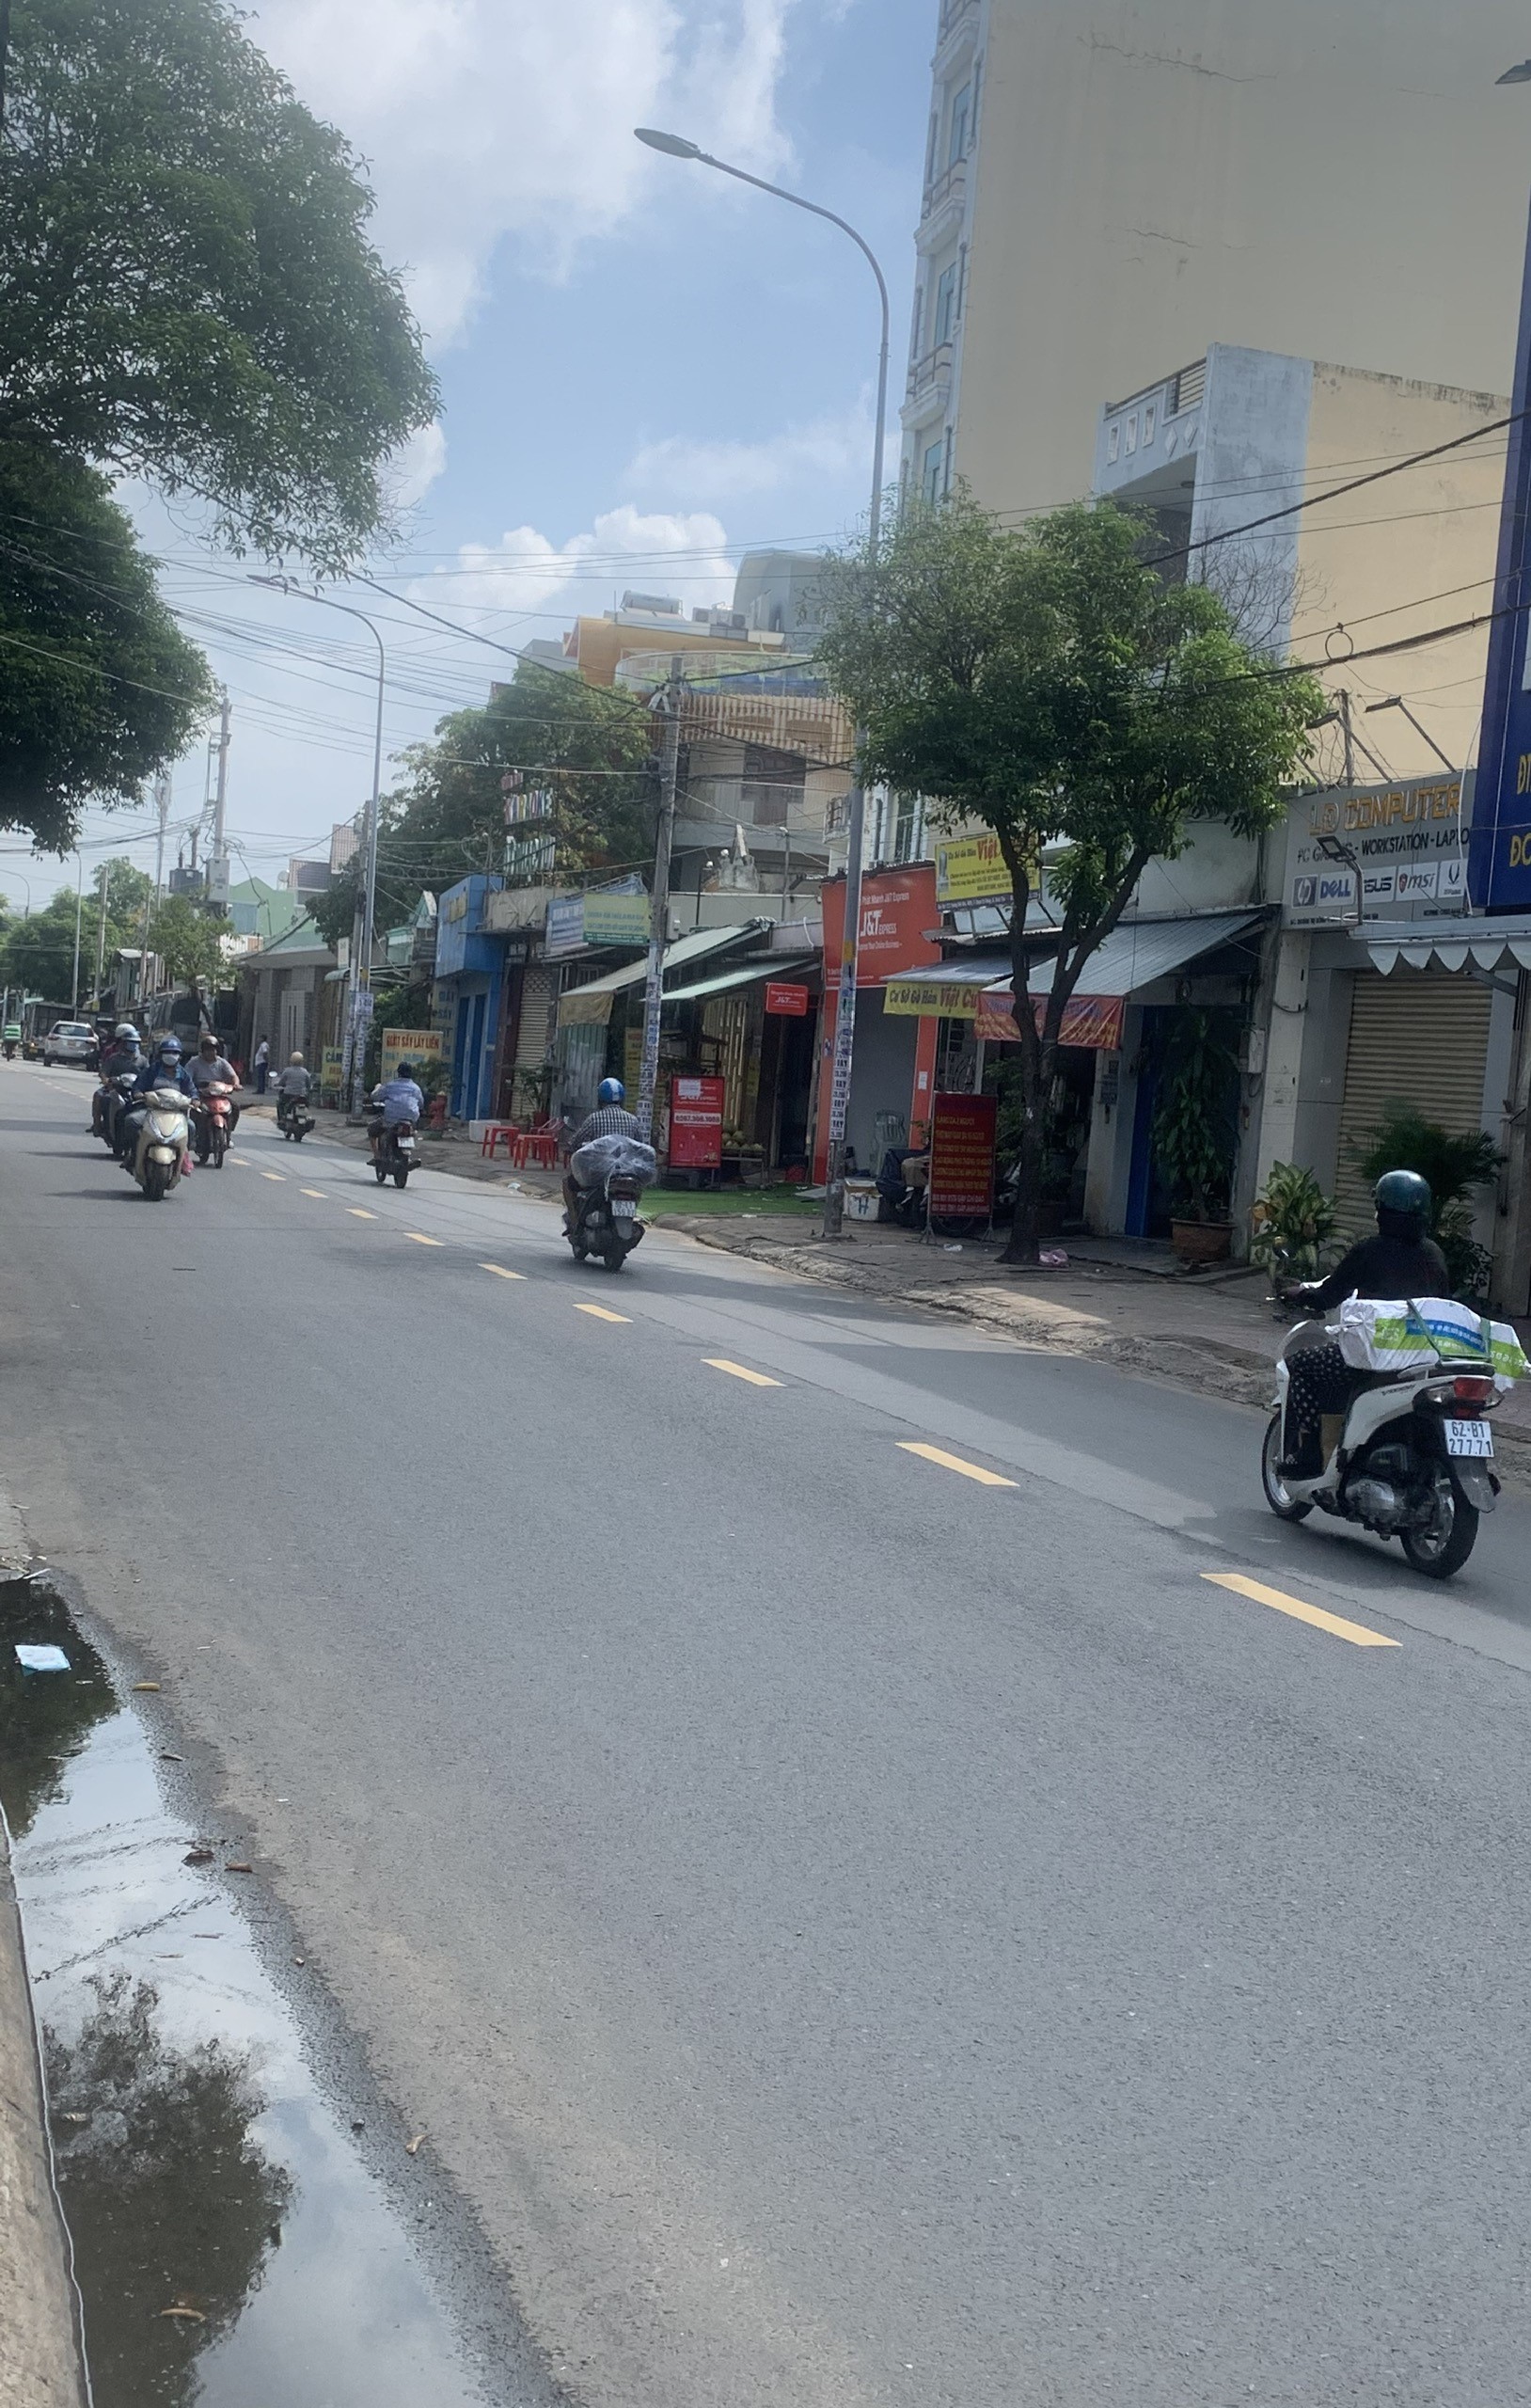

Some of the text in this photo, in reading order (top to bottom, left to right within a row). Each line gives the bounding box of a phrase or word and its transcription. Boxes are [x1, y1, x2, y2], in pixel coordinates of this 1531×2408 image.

[1344, 784, 1461, 831] COMPUTER
[1362, 832, 1429, 856] WORKSTATION
[1320, 879, 1351, 899] DELL
[1363, 876, 1393, 894] SUS
[860, 909, 883, 937] J&T
[940, 985, 960, 1014] Việt
